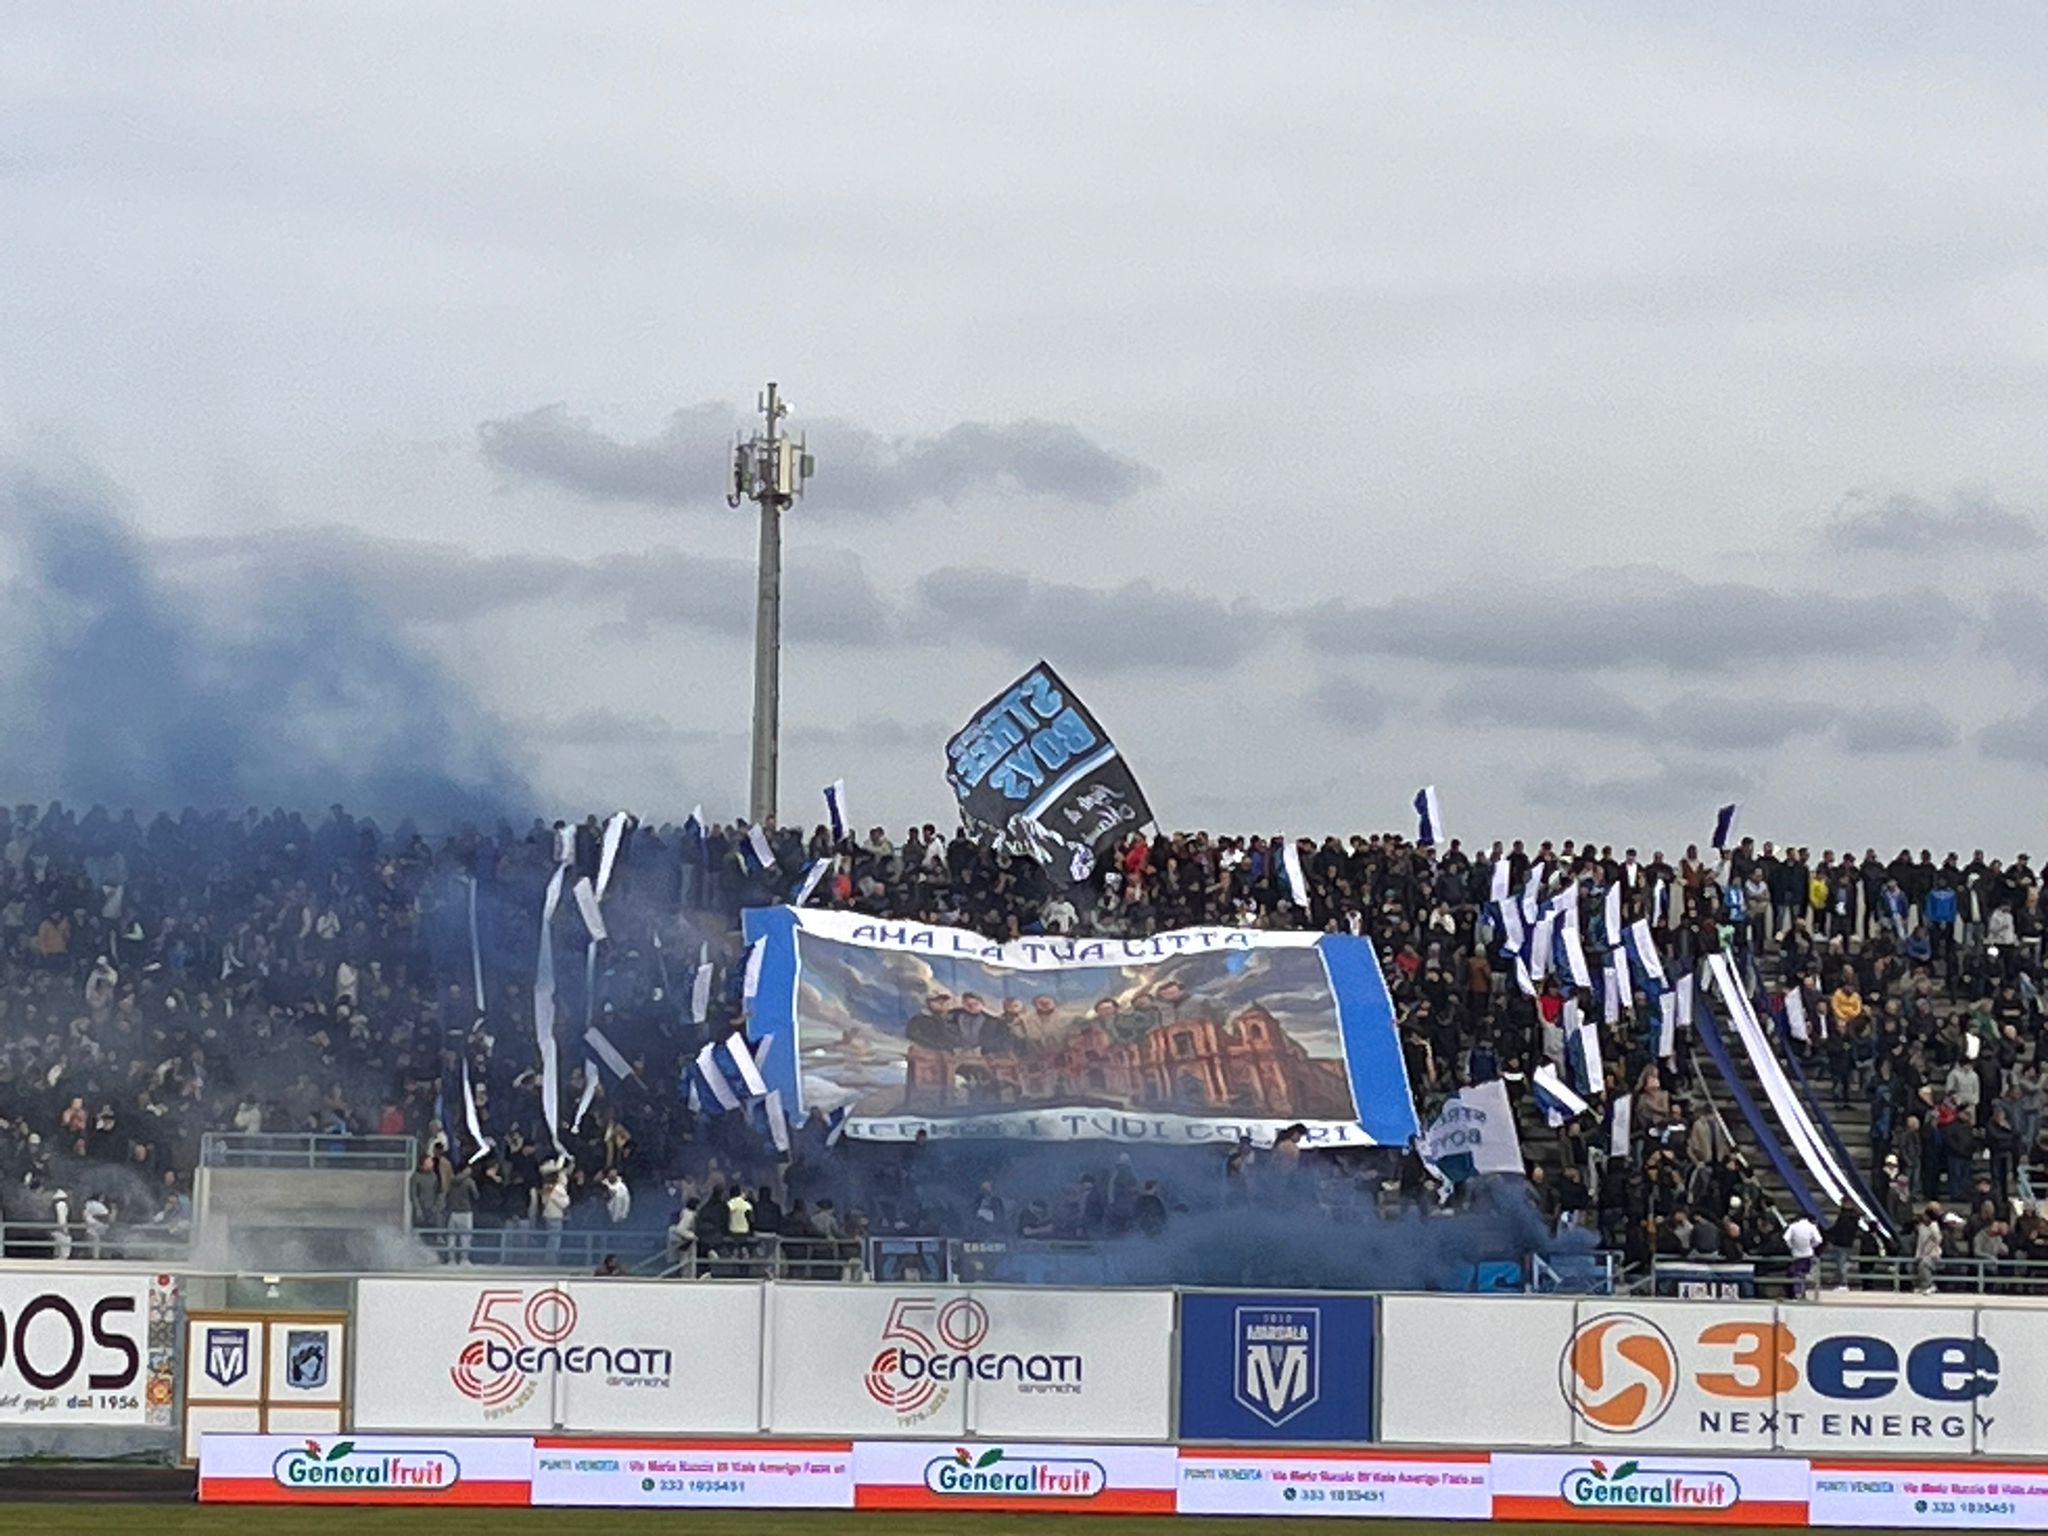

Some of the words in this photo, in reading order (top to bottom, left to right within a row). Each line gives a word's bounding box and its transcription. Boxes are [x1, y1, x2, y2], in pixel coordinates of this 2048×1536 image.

[852, 924, 934, 949] AMA
[953, 935, 1004, 961] LA
[1022, 942, 1105, 964] TUA
[0, 1293, 140, 1391] OS
[100, 1395, 139, 1410] 1956
[1700, 1411, 1805, 1435] NEXT
[1821, 1413, 1996, 1438] ENERGY
